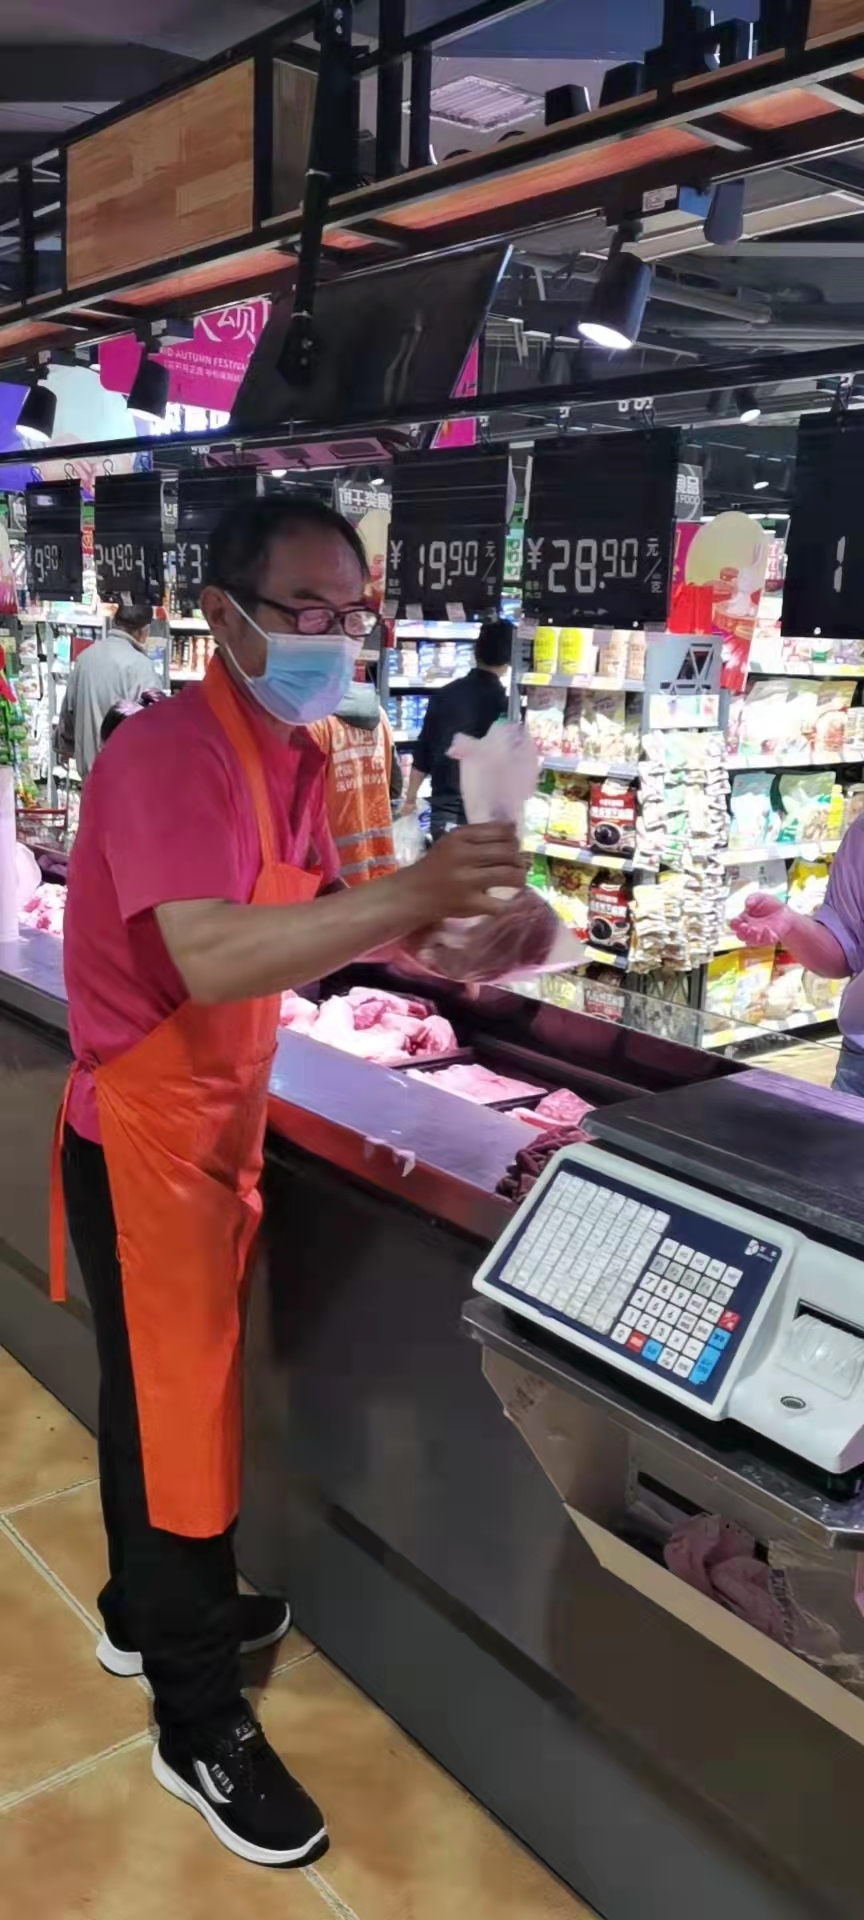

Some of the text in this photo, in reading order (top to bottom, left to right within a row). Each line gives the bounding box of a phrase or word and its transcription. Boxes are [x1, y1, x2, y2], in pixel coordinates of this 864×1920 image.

[175, 350, 212, 365] AUTUMN
[418, 540, 479, 590] 19.90
[547, 538, 639, 593] 28.90
